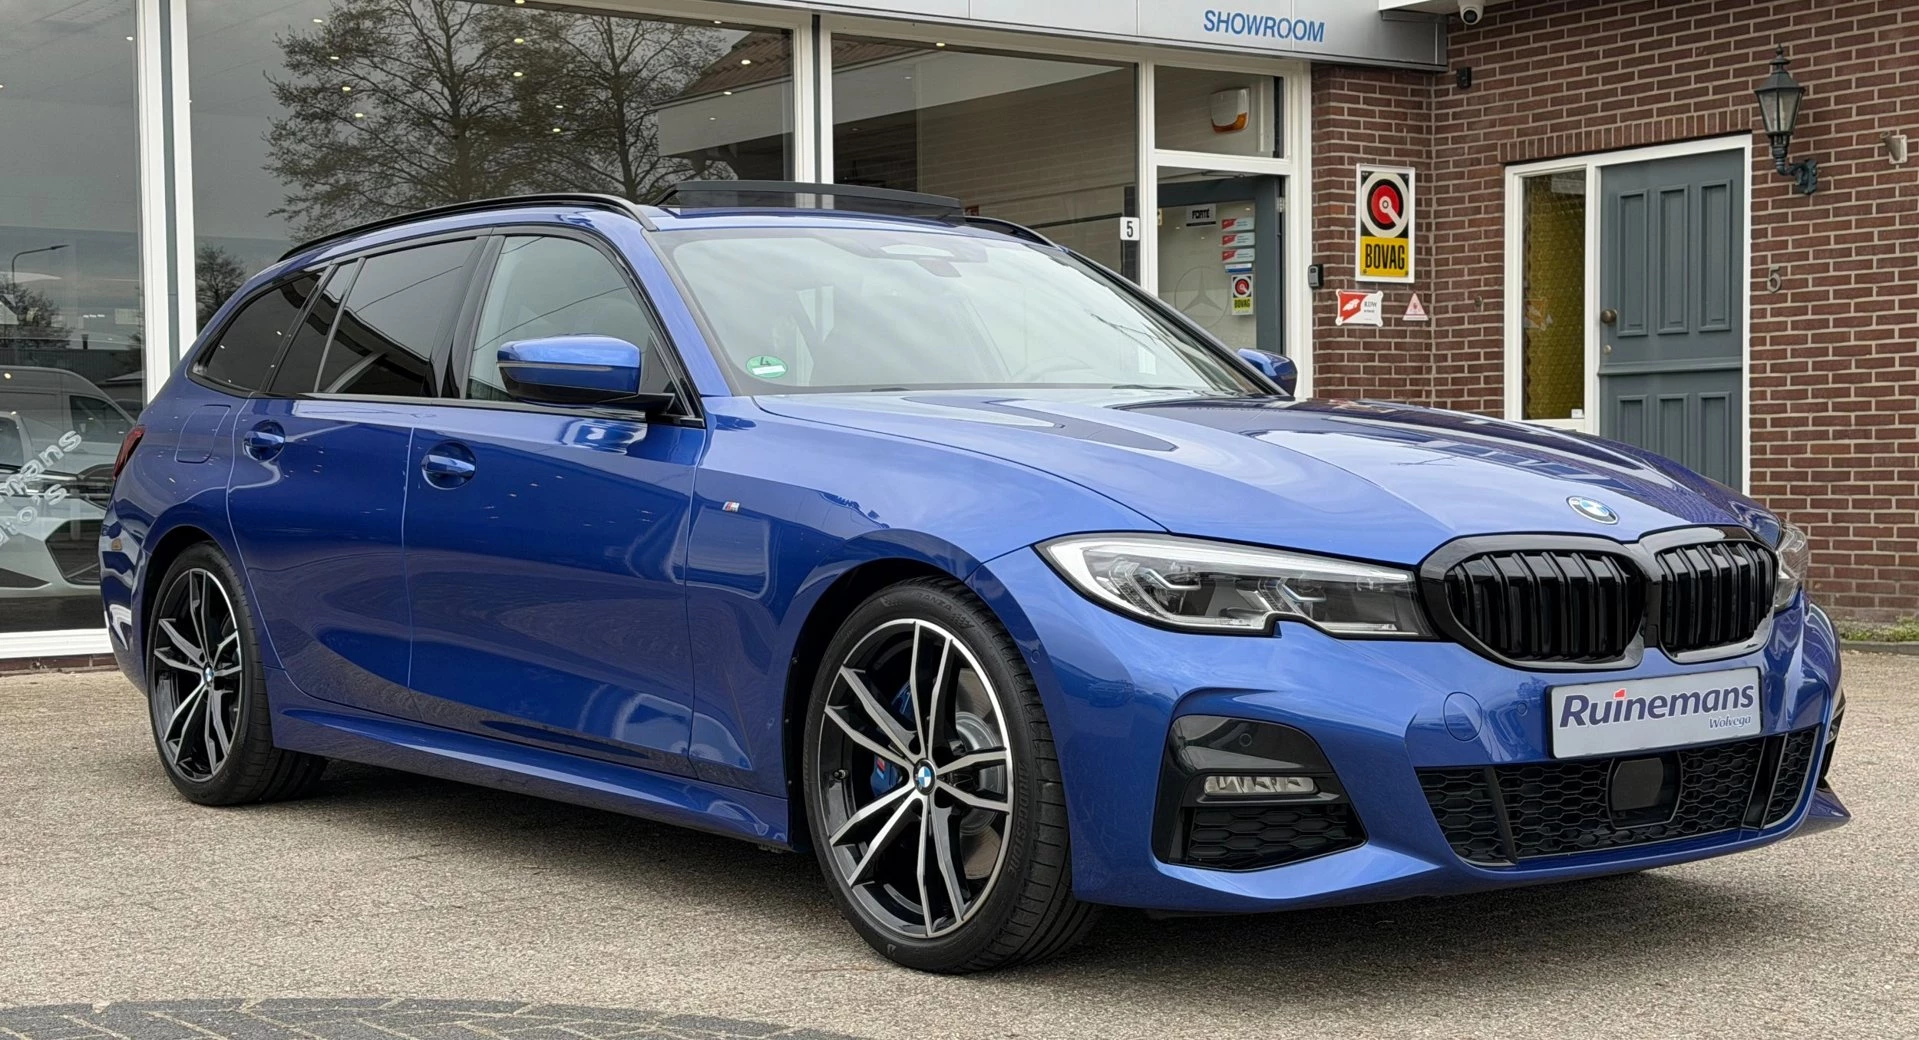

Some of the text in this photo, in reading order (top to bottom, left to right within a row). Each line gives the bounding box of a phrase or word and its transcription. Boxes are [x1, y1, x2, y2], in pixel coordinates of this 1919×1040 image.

[1203, 9, 1325, 43] SHOWROOM
[1125, 220, 1134, 238] 5
[1365, 243, 1405, 270] BOVAG
[1766, 264, 1781, 293] 5
[1234, 298, 1251, 309] BOVAG
[1559, 684, 1755, 729] Ruinemans
[1708, 715, 1752, 729] Wolvega
